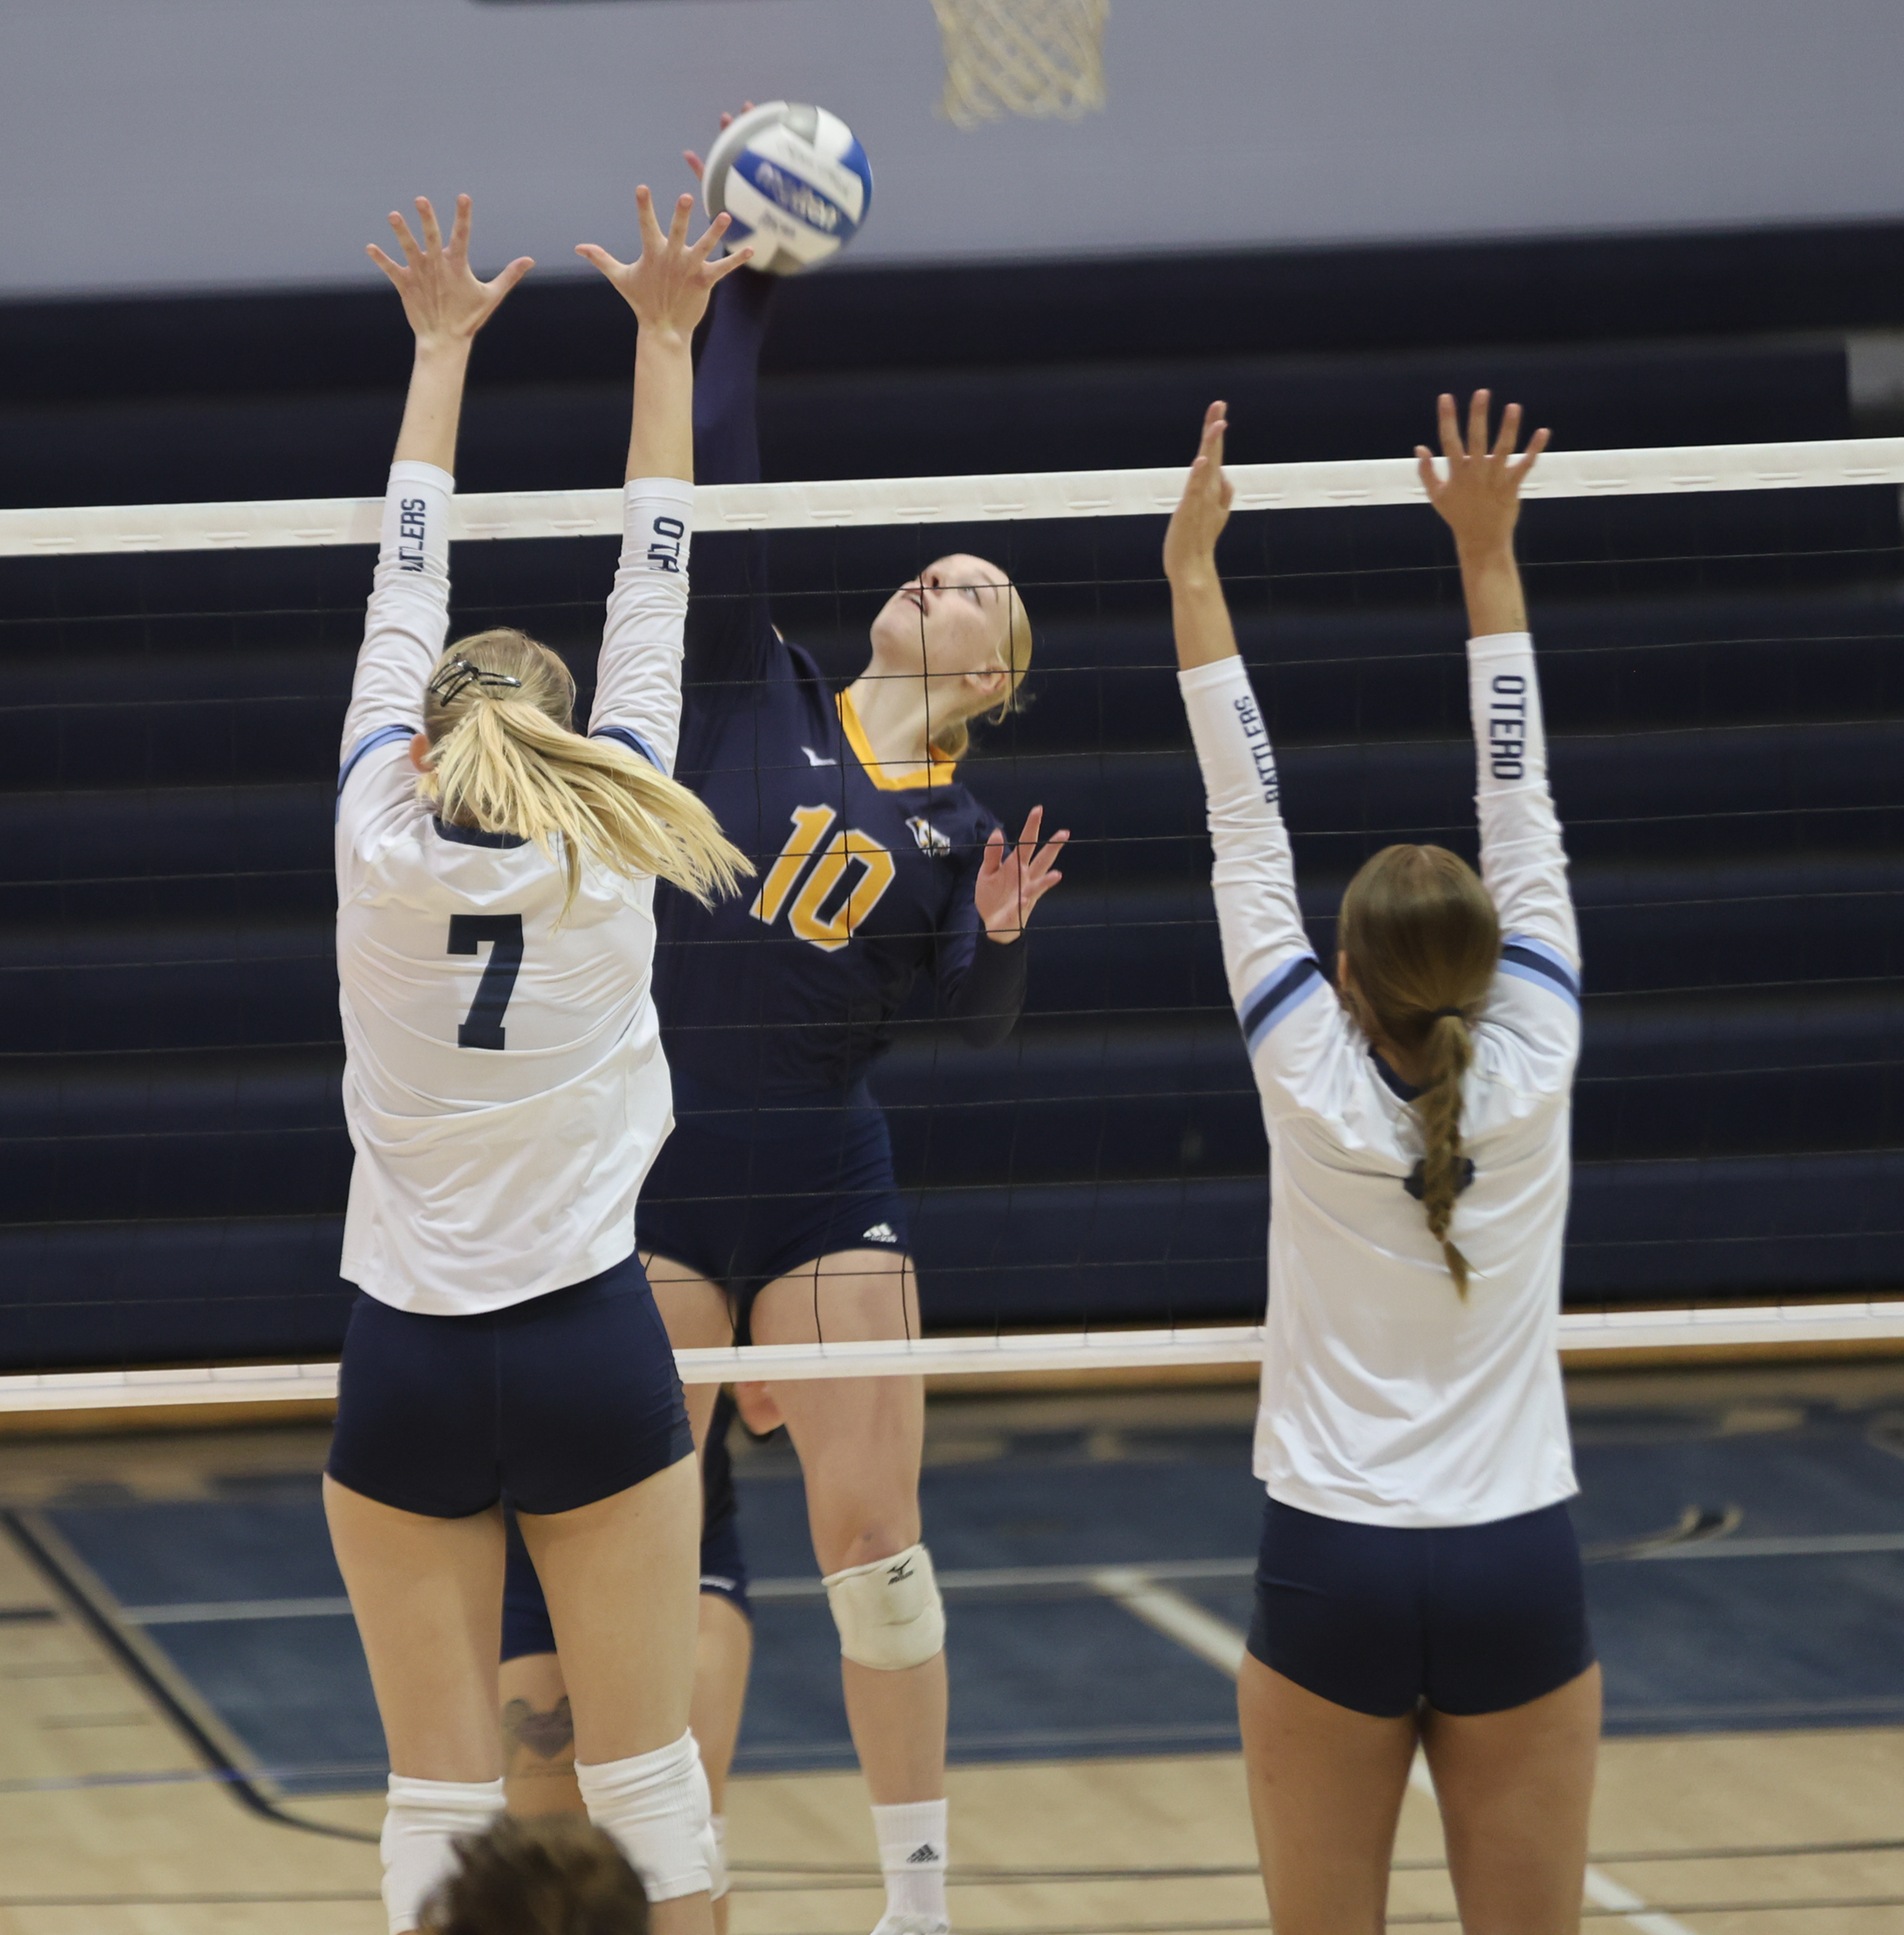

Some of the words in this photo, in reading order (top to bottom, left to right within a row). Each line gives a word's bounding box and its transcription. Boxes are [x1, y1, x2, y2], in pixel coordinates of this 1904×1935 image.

[1490, 674, 1527, 780] OTERO
[749, 803, 896, 953] 10
[446, 913, 525, 1051] 7
